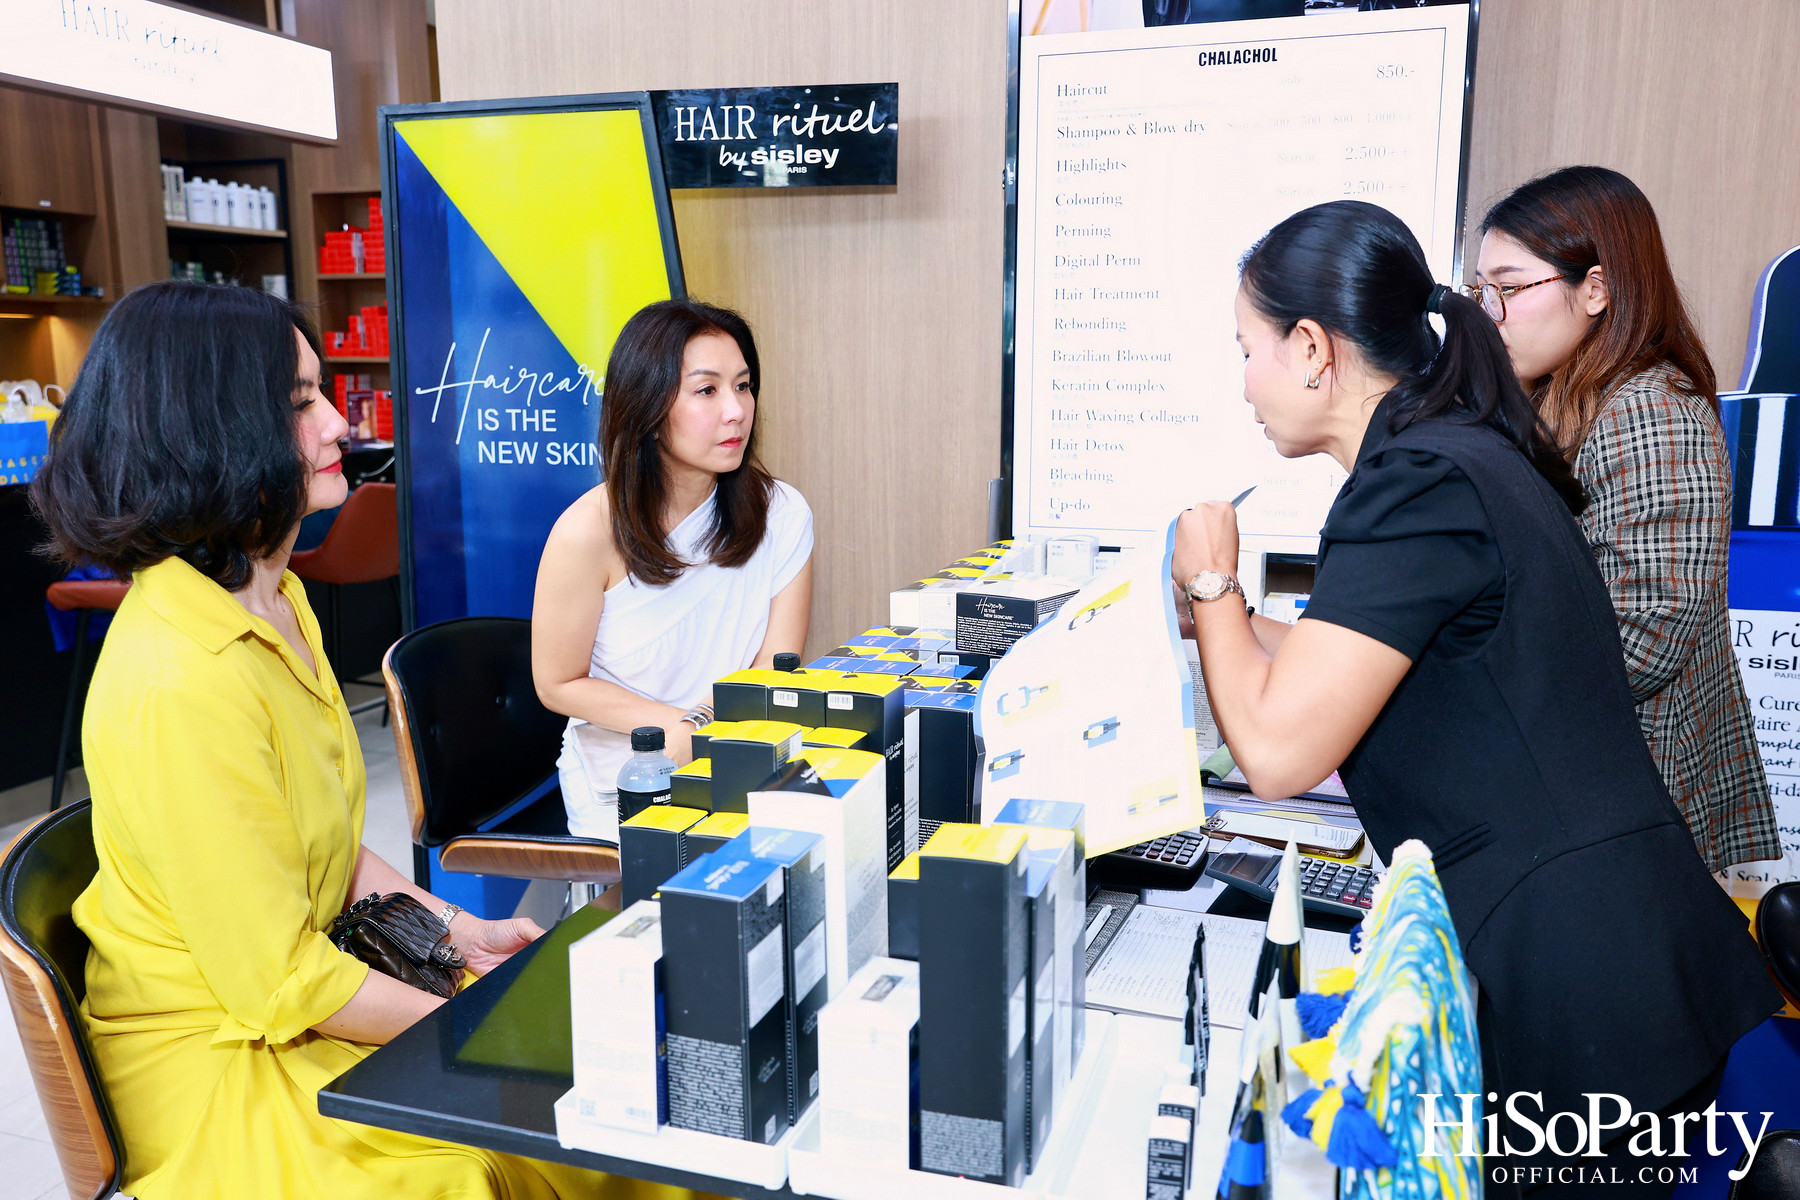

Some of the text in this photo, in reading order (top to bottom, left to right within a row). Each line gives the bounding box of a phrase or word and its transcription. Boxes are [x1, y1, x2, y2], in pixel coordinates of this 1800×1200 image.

[1198, 47, 1278, 67] CHALACHOL
[1057, 83, 1109, 98] Haircut
[674, 100, 886, 142] HAIR rituel
[1057, 125, 1121, 141] Shampoo
[1126, 123, 1138, 136] &
[1144, 121, 1178, 135] Blow
[1184, 119, 1207, 136] dry
[719, 143, 840, 172] by sisley
[782, 166, 808, 174] PARIS
[1057, 159, 1128, 175] Highlights
[1055, 192, 1123, 208] Colouring
[1055, 223, 1112, 240] Perming
[1055, 253, 1142, 270] Digital Perm
[1055, 286, 1160, 301] Hair Treatment
[1054, 317, 1127, 333] Rebonding
[1052, 349, 1172, 363] Brazilian Blowout
[1052, 379, 1166, 395] Keratin Complex
[477, 408, 557, 432] IS THE
[1051, 409, 1200, 426] Hair Waxing Collagen
[477, 441, 539, 465] NEW
[1050, 438, 1126, 453] Hair Detox
[1050, 468, 1114, 484] Bleaching
[1049, 498, 1091, 513] Up-do
